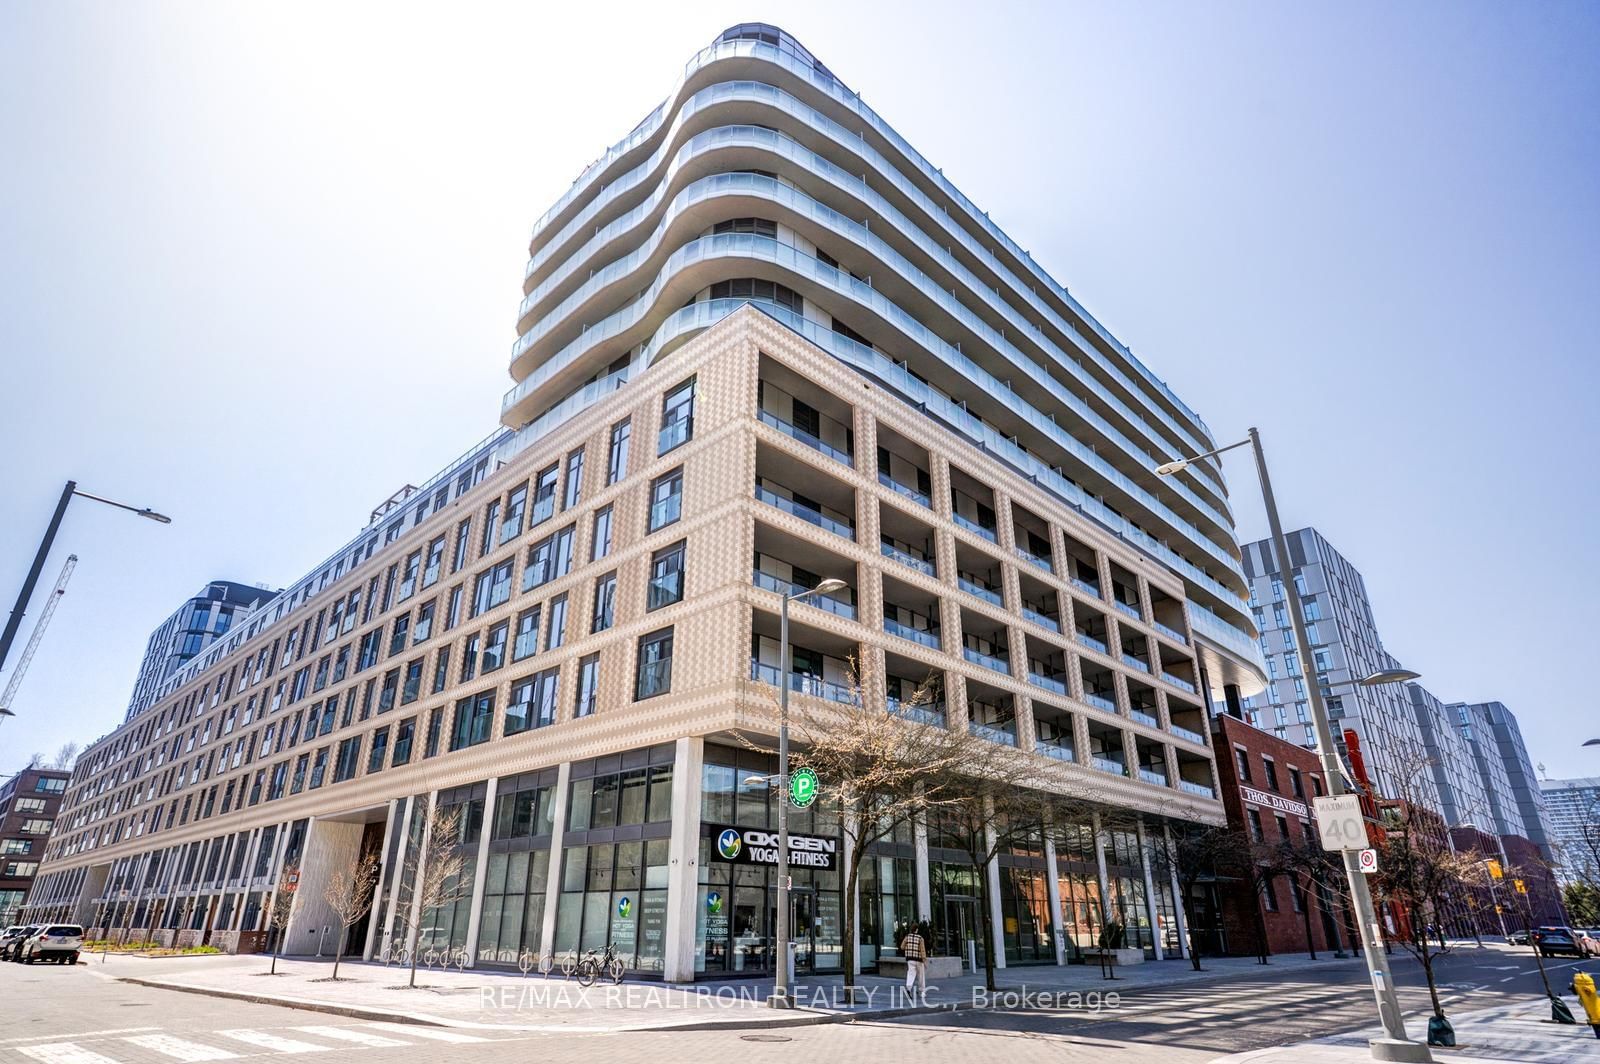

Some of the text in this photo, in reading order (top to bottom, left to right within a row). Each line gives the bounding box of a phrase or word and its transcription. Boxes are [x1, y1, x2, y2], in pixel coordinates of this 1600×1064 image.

[798, 777, 810, 795] P
[1245, 789, 1271, 805] THOS.
[1318, 800, 1356, 812] MAXIMUM
[1325, 817, 1361, 842] 40
[743, 831, 835, 852] OXGEN
[749, 847, 779, 863] YOGA
[791, 851, 830, 867] FITNESS
